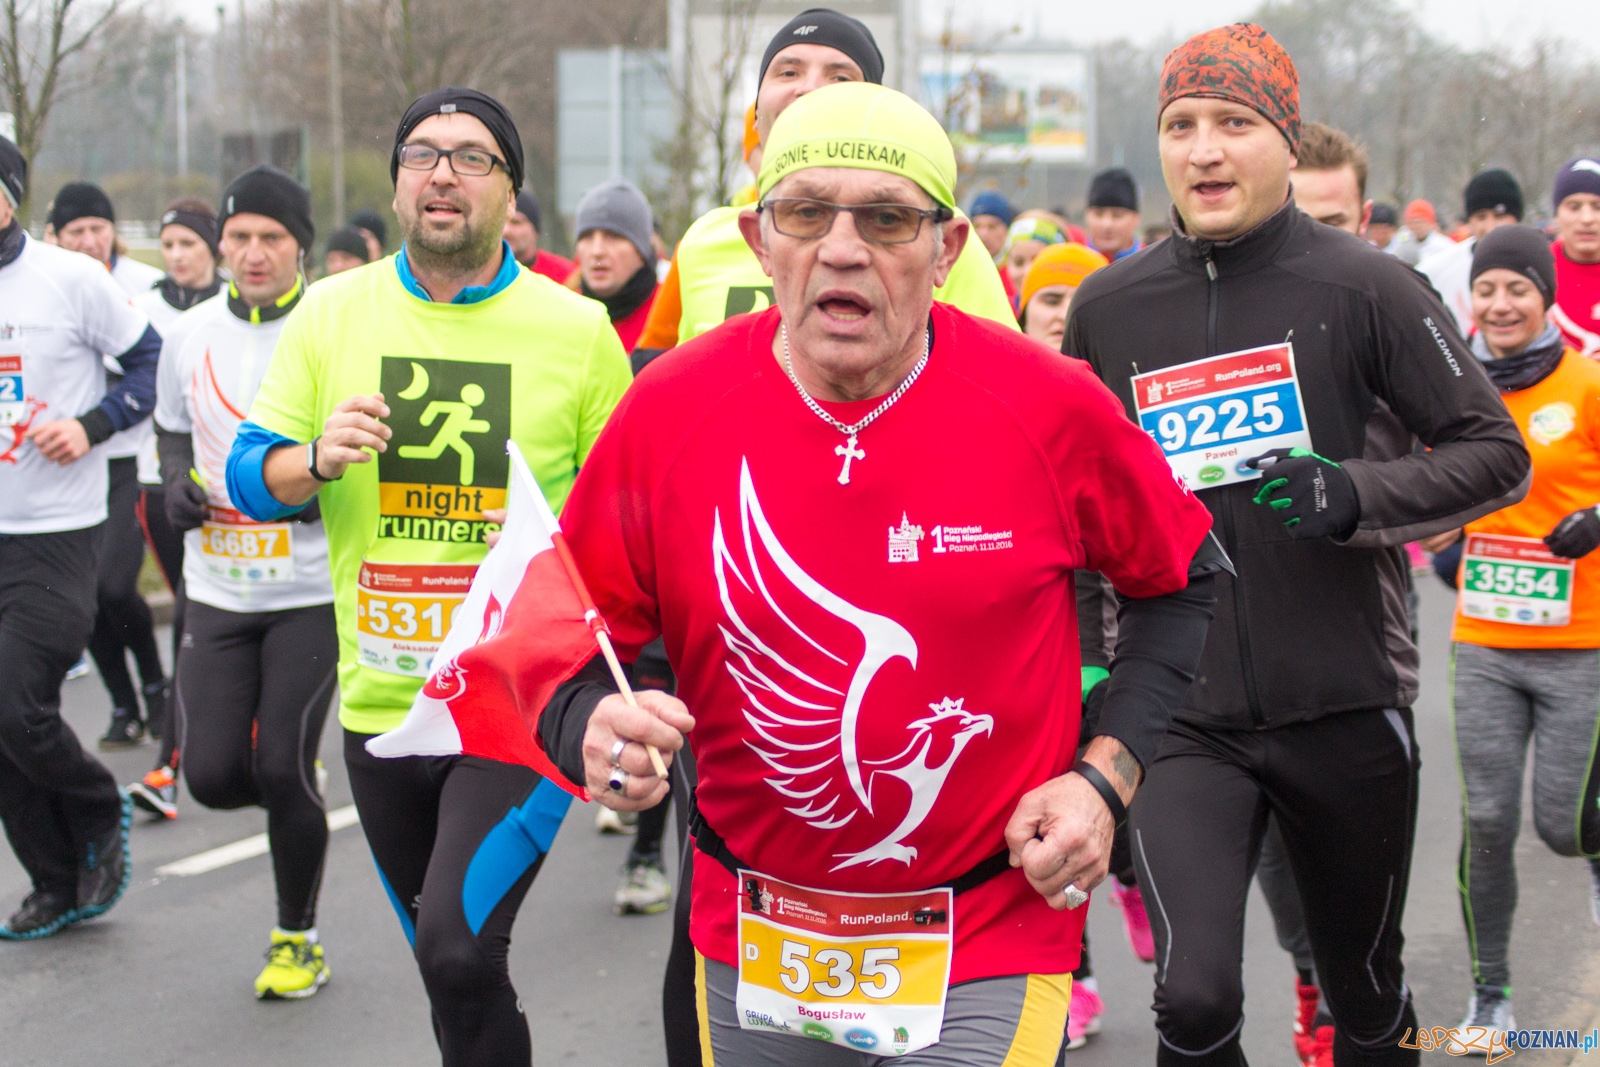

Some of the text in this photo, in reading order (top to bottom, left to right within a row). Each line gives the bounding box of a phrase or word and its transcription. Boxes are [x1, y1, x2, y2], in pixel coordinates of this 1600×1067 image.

[775, 144, 809, 173] GONIĘ
[826, 142, 906, 169] UCIEKAM
[1422, 316, 1463, 377] SALOMON
[1215, 363, 1282, 382] RunPoland.org
[1158, 391, 1284, 451] 9225
[406, 484, 483, 516] night
[1313, 478, 1321, 511] running
[210, 529, 279, 557] 6687
[379, 516, 501, 542] runners
[930, 525, 946, 553] 1
[943, 525, 982, 534] Poznański
[943, 530, 1013, 543] Bieg Niepodległości
[949, 540, 1013, 552] Poznań, 11.11.2016
[1473, 563, 1560, 598] 3554
[745, 943, 759, 961] D
[779, 939, 901, 999] 535
[745, 1009, 774, 1023] GRUPA
[797, 1005, 866, 1021] Bogusław
